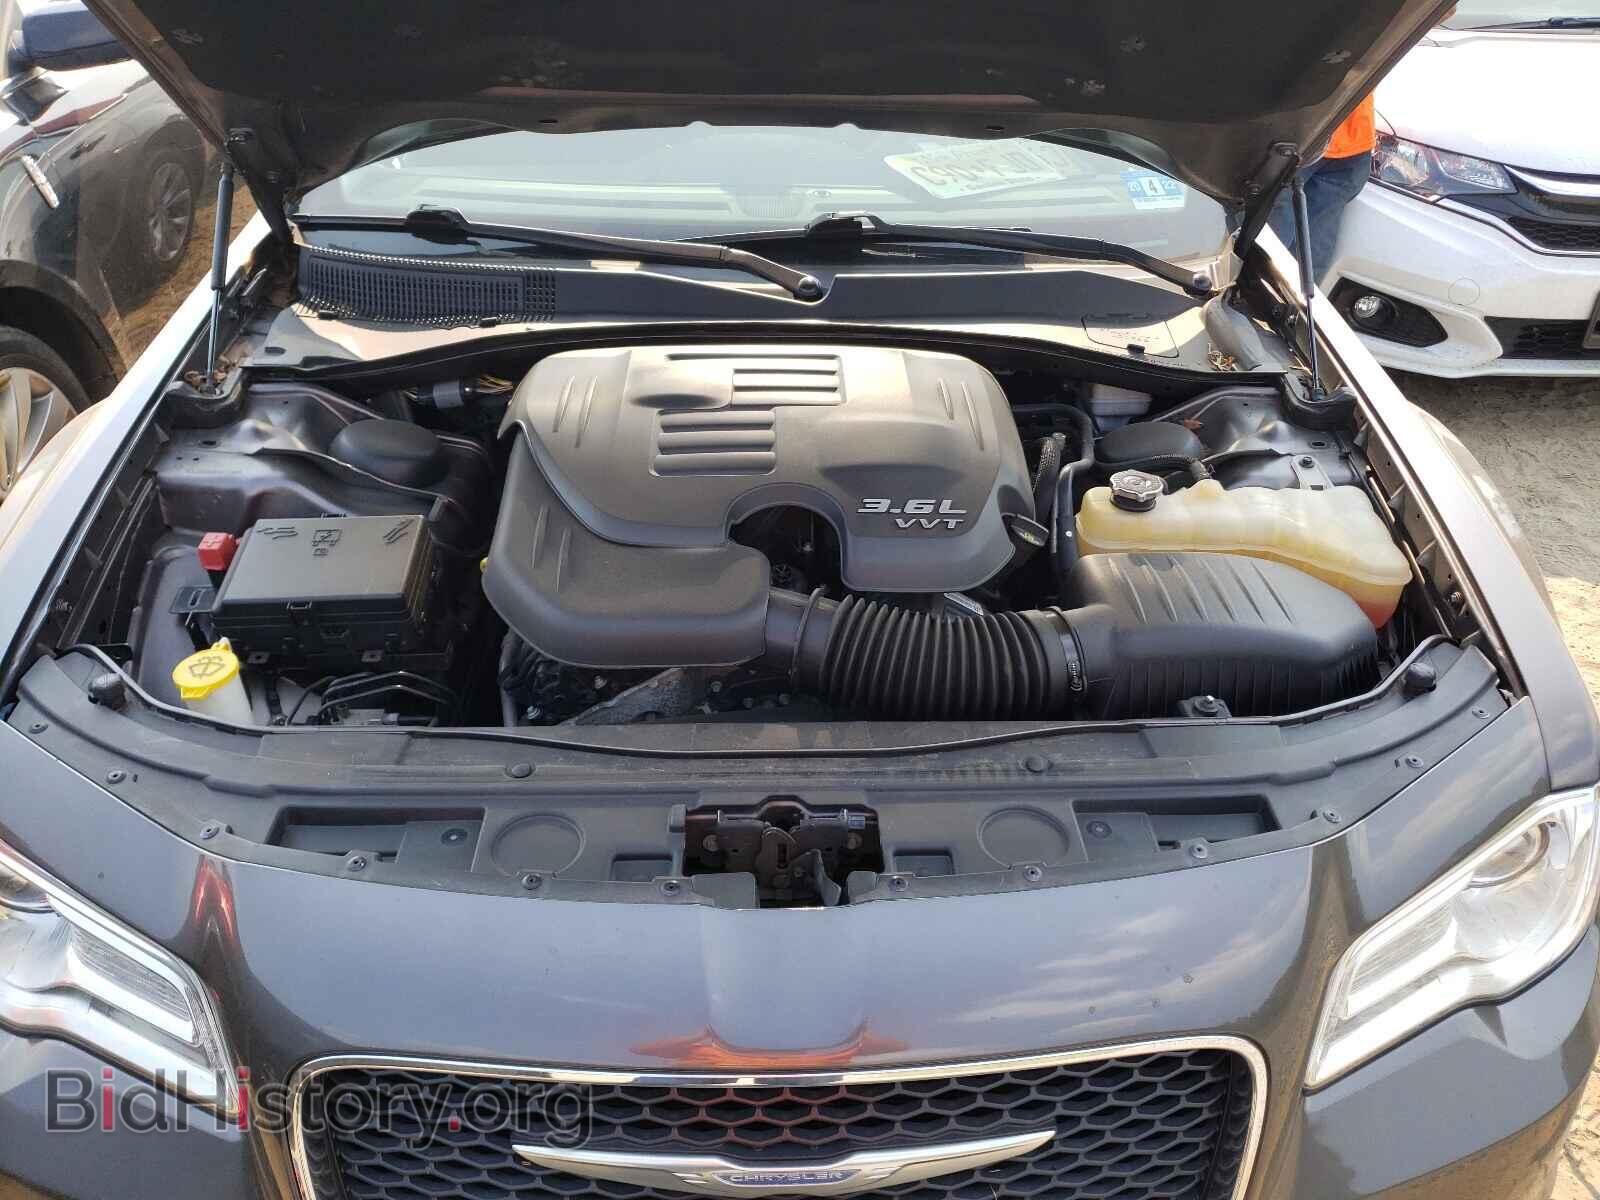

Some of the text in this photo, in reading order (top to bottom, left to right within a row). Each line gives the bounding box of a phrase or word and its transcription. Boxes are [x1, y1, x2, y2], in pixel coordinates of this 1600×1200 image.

[857, 498, 967, 514] 3.6L
[895, 518, 964, 529] VVT
[729, 1171, 843, 1182] CHRYSLER
